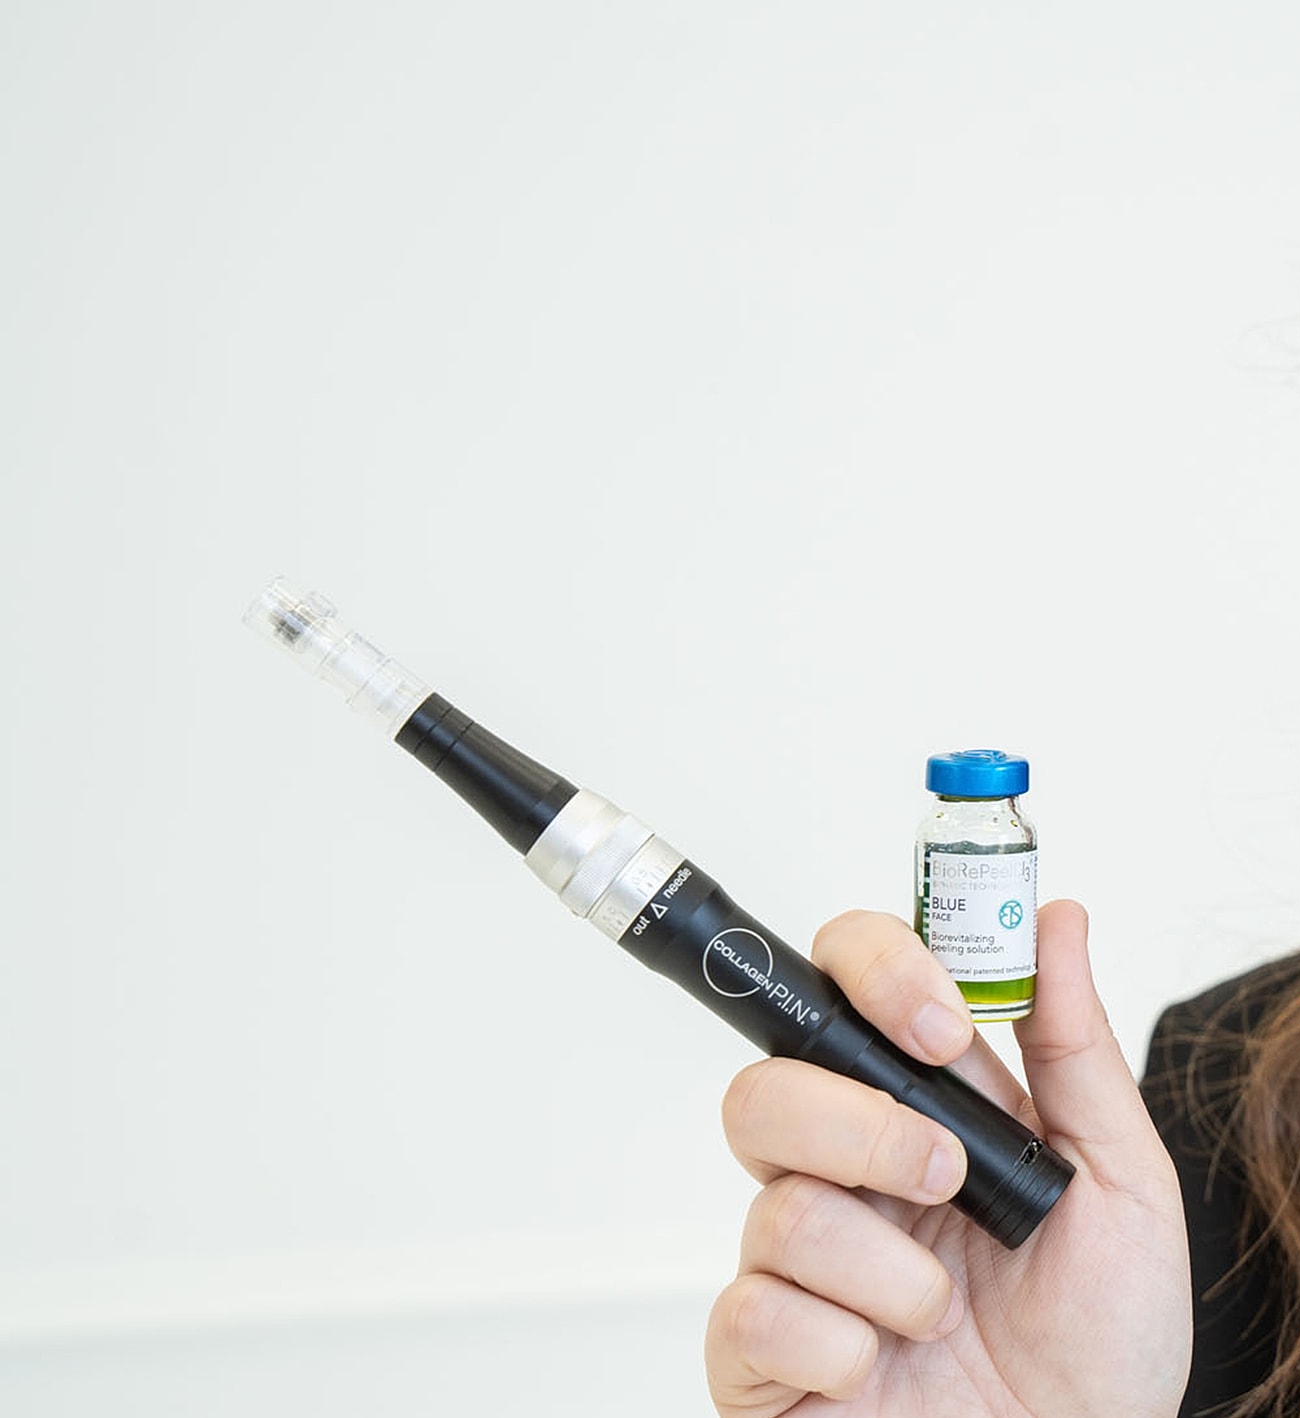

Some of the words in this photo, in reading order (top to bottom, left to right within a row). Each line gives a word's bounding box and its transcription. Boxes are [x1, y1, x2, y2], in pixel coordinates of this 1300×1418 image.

[633, 917, 651, 936] out
[663, 867, 693, 900] needle
[932, 896, 967, 911] BLUE
[932, 913, 952, 922] FACE
[931, 931, 995, 945] Biorevitalizing
[931, 944, 967, 956] peeling
[967, 944, 1004, 954] solution
[713, 940, 773, 991] COLLAGEN
